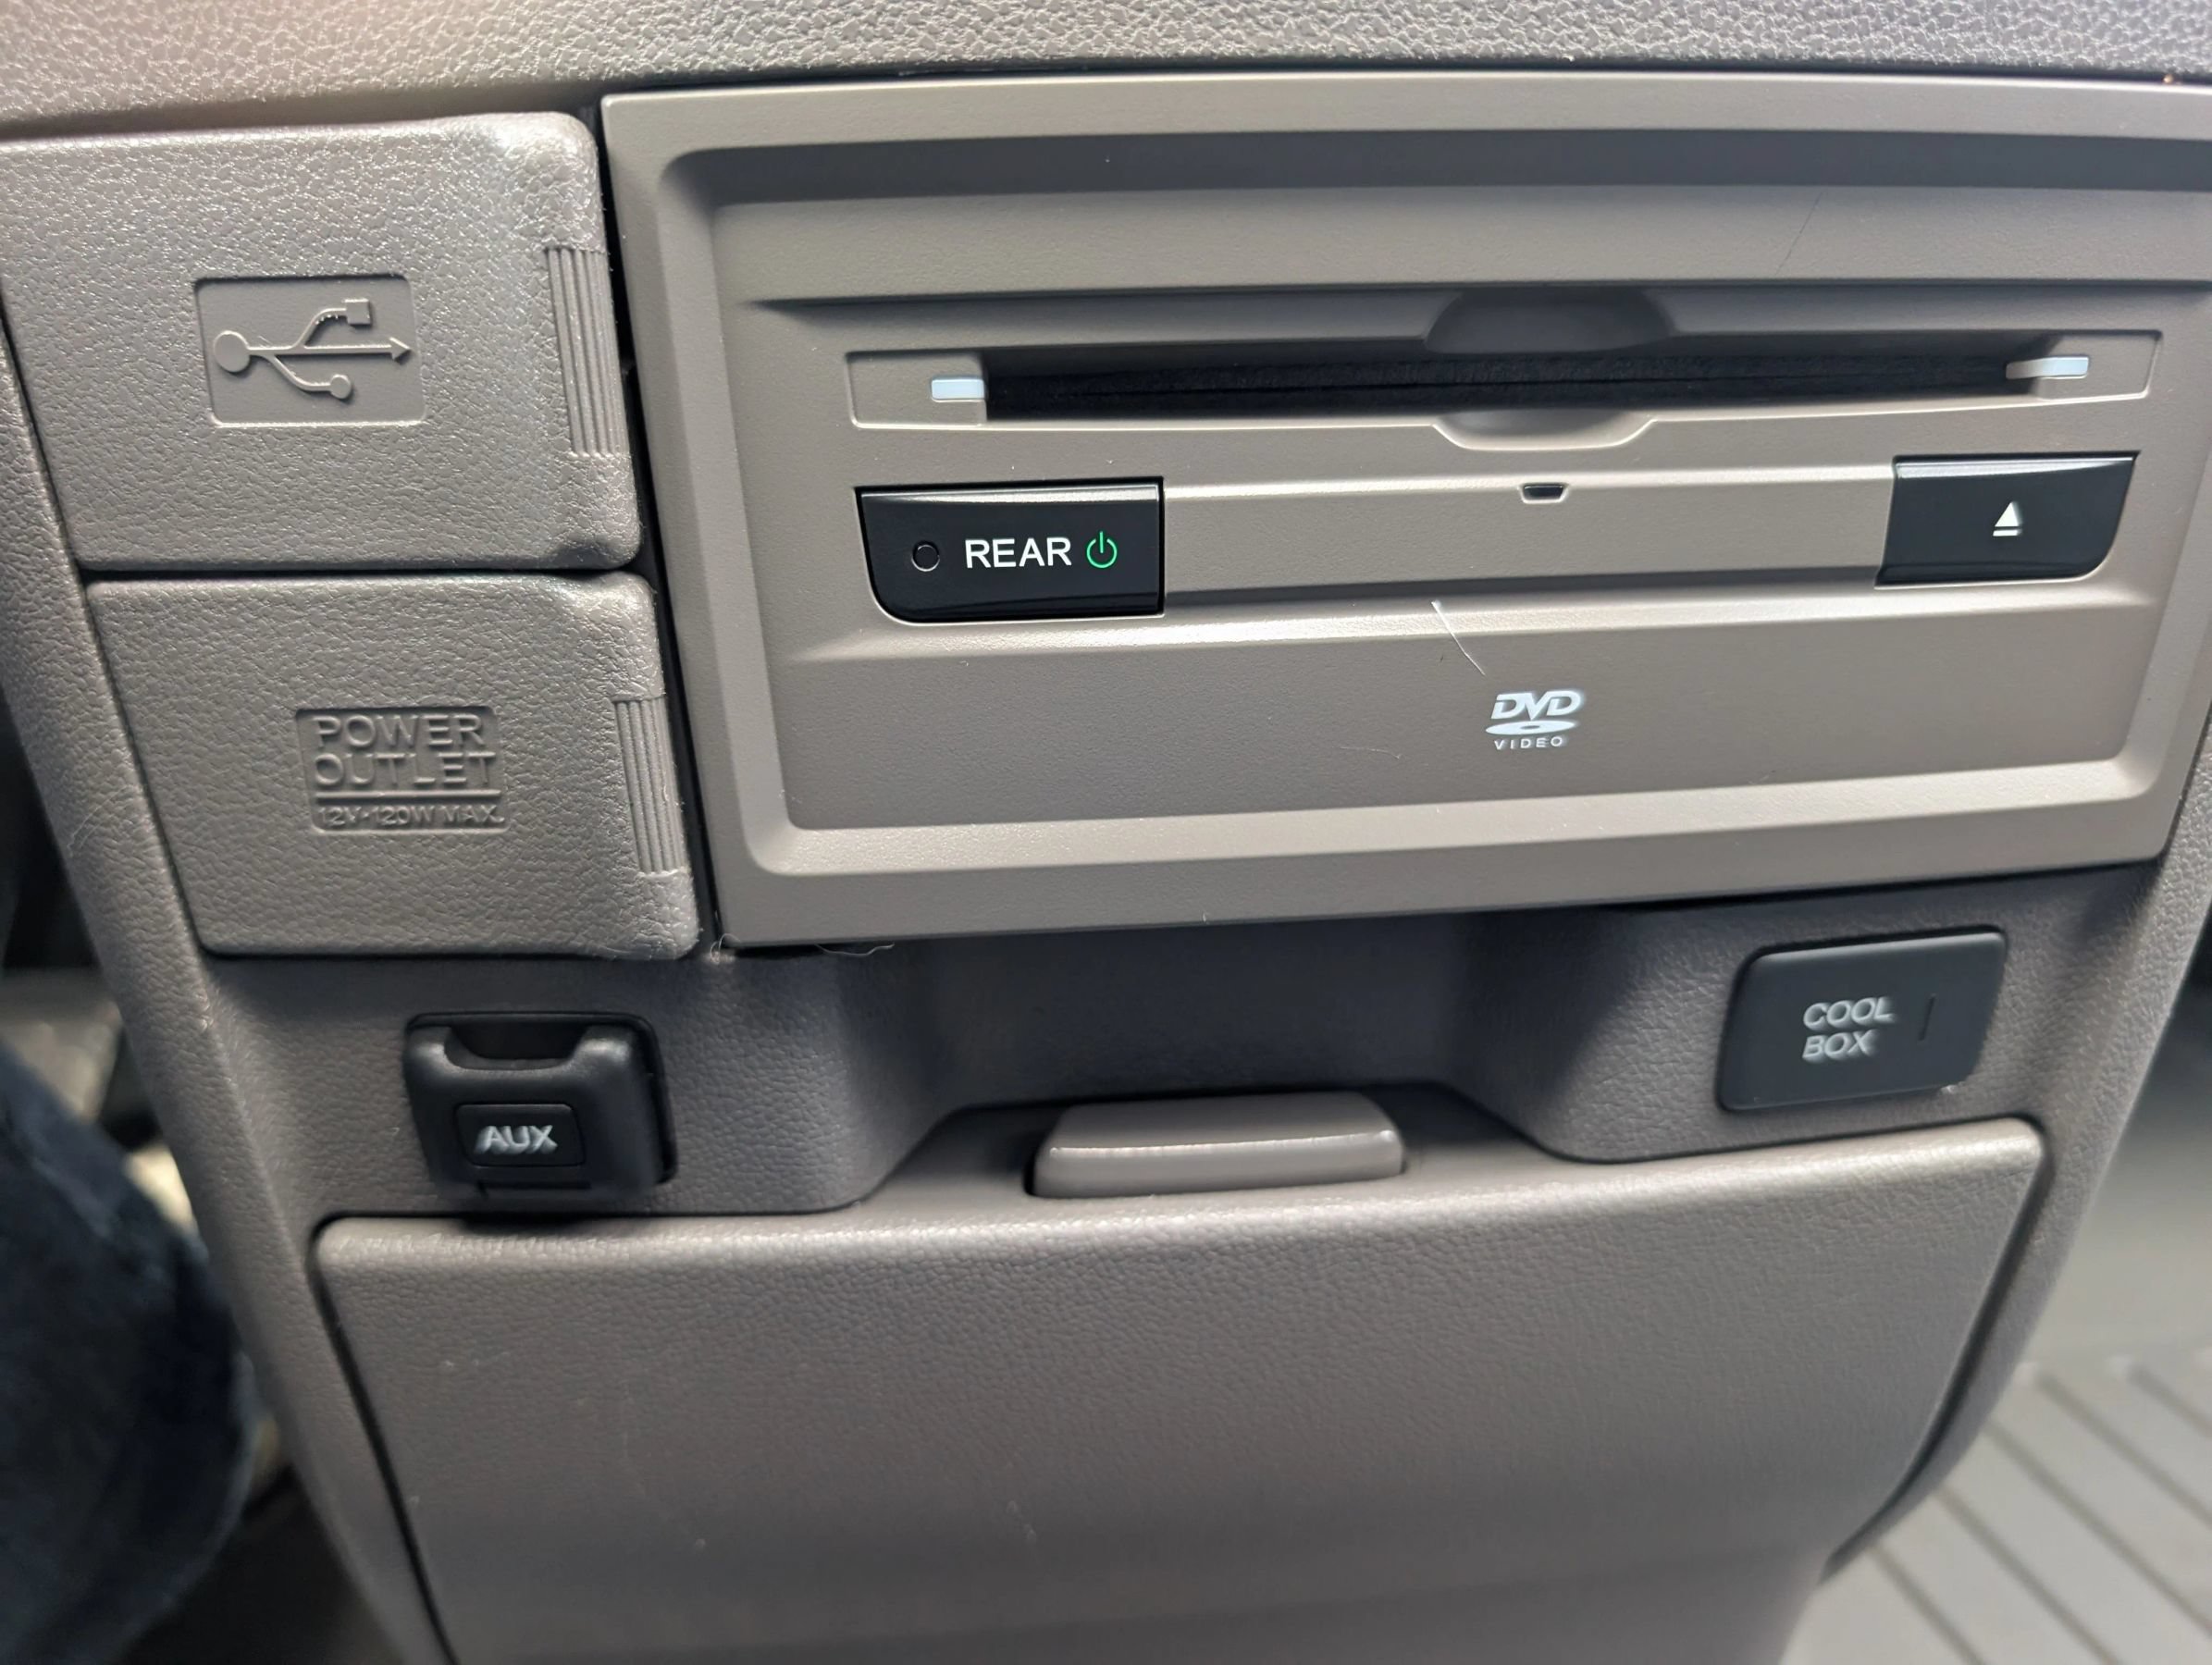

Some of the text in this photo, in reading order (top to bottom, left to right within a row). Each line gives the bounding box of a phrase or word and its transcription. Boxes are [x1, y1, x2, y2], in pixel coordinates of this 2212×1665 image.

[965, 536, 1072, 569] REAR
[1490, 690, 1582, 721] DVD
[312, 714, 487, 747] POWER
[1494, 736, 1565, 750] VIDEO
[313, 751, 497, 786] OUTLET
[1803, 996, 1897, 1031] COOL
[1802, 1028, 1879, 1063] BOX
[473, 1125, 559, 1154] AUX
